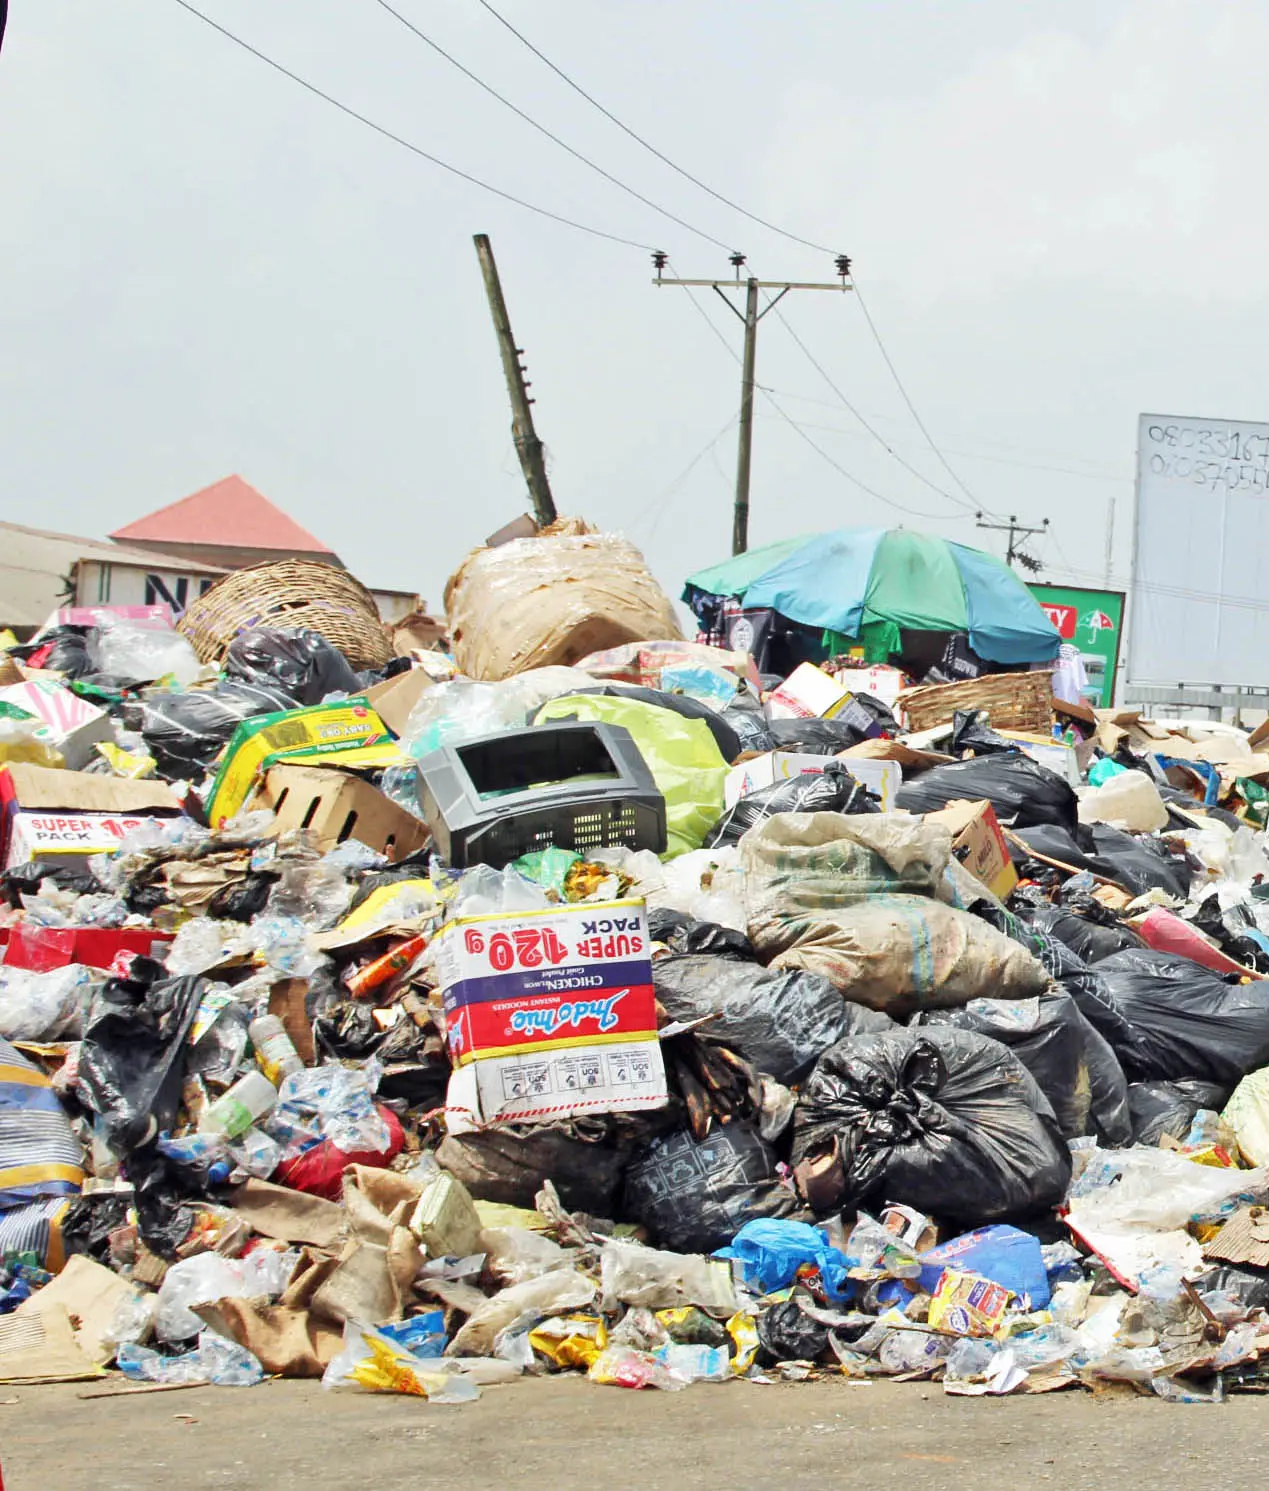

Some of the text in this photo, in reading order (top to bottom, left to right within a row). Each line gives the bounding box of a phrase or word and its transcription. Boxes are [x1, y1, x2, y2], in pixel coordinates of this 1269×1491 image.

[145, 574, 213, 613] N
[31, 818, 93, 832] SUPER
[35, 832, 91, 841] PACK
[582, 917, 640, 934] PACK
[576, 934, 644, 958] SUPER
[547, 975, 603, 990] CHICKEN
[492, 996, 561, 1011] INSTANT NOODLES
[510, 989, 630, 1036] Indomie
